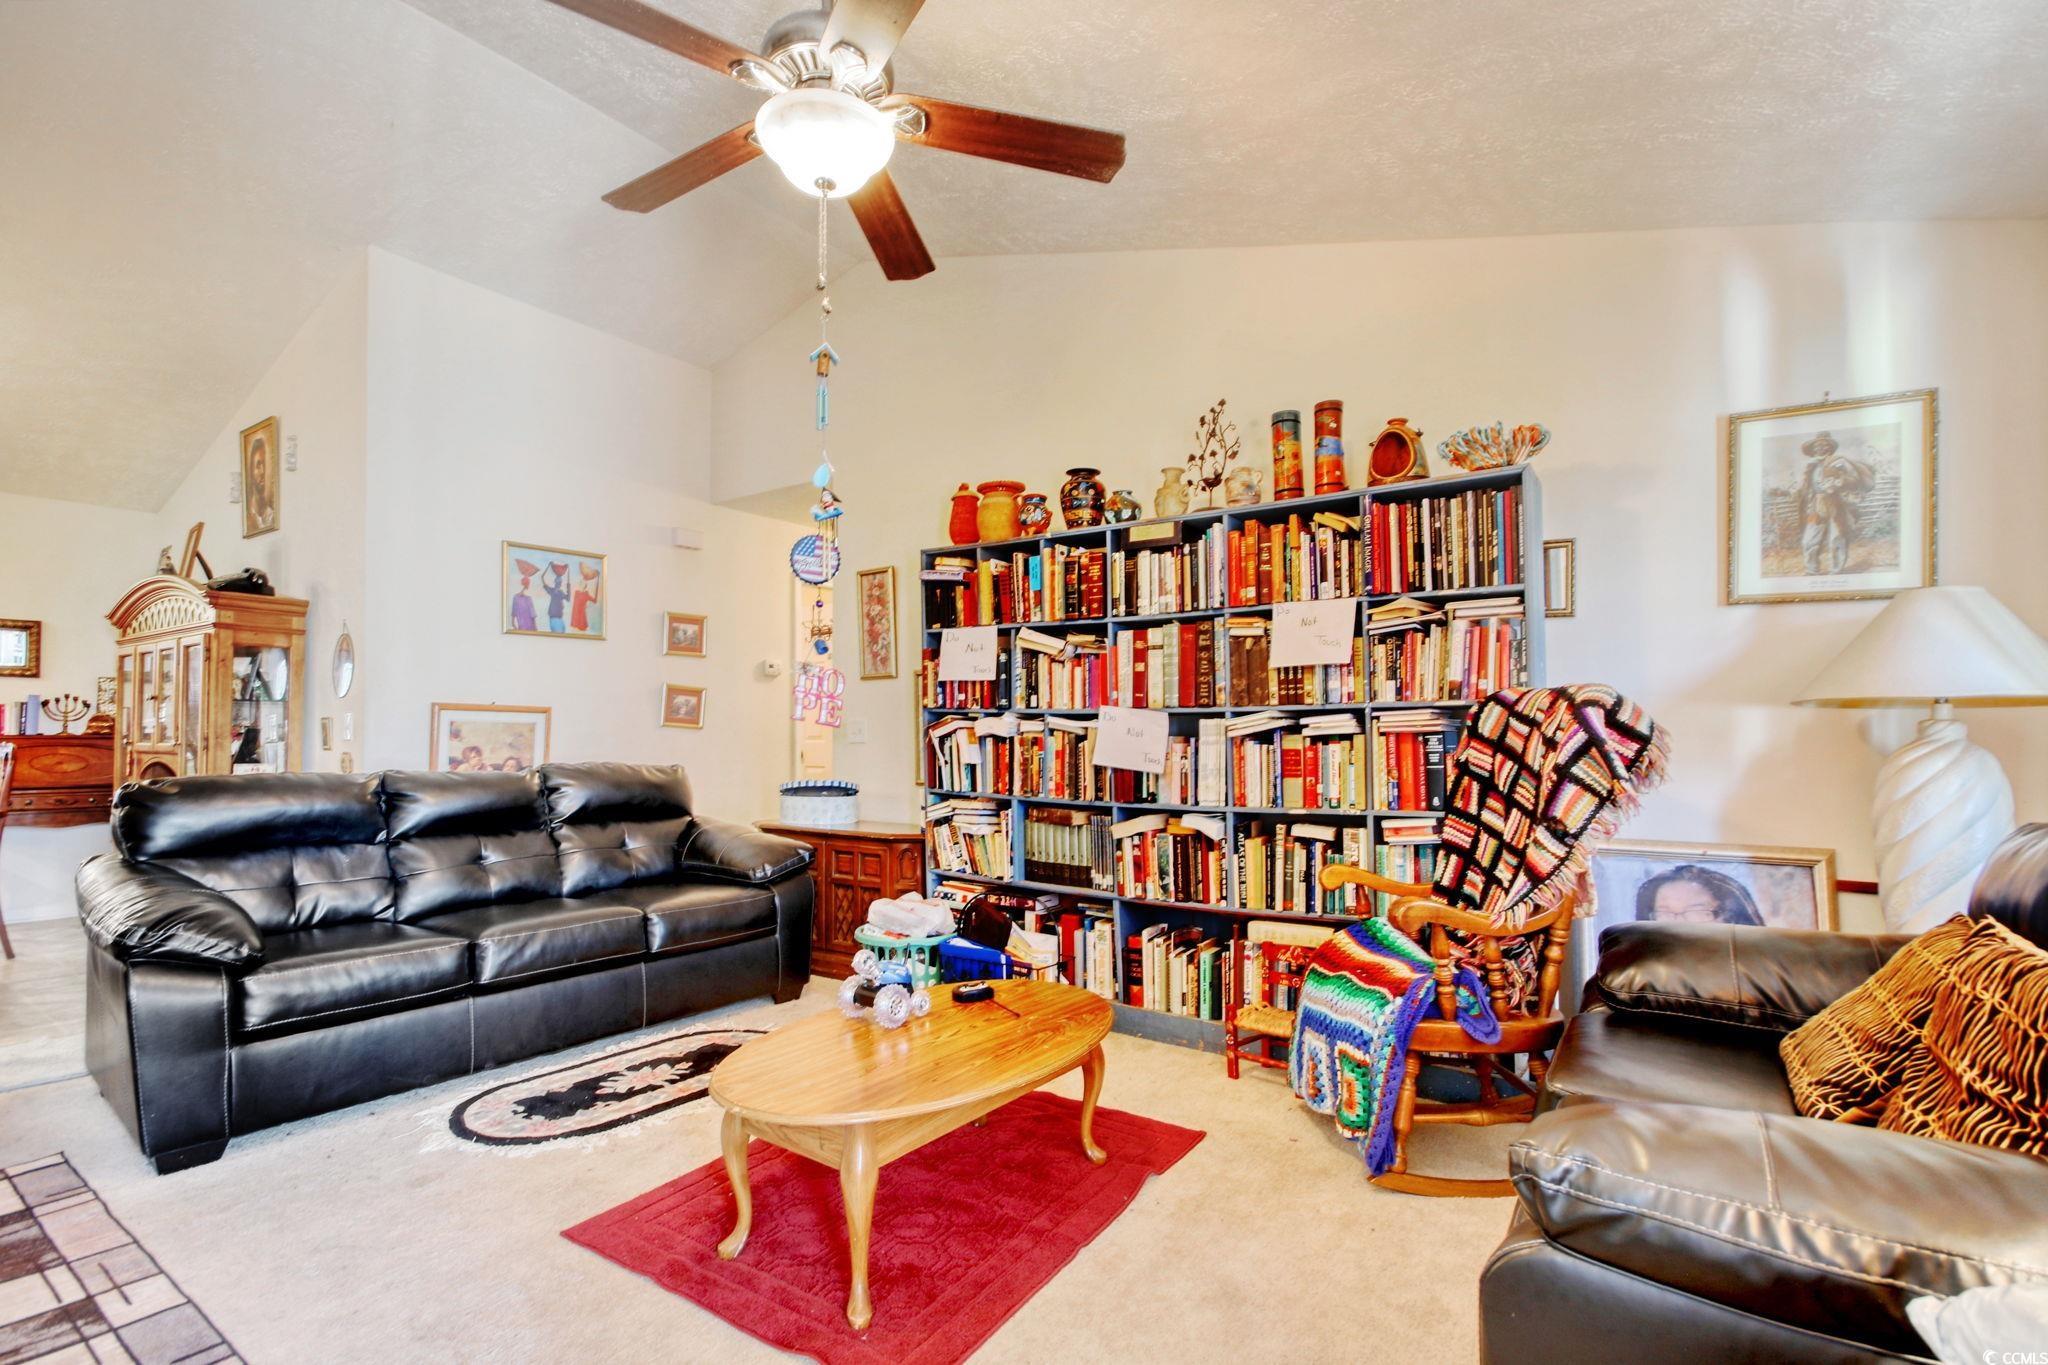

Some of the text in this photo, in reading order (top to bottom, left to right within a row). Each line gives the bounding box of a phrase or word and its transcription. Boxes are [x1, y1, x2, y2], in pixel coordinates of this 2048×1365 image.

[1363, 545, 1373, 574] IMAGES
[1300, 616, 1319, 627] Not
[1313, 634, 1342, 648] Touch
[1237, 832, 1246, 857] ATLAS
[1239, 866, 1247, 882] THE
